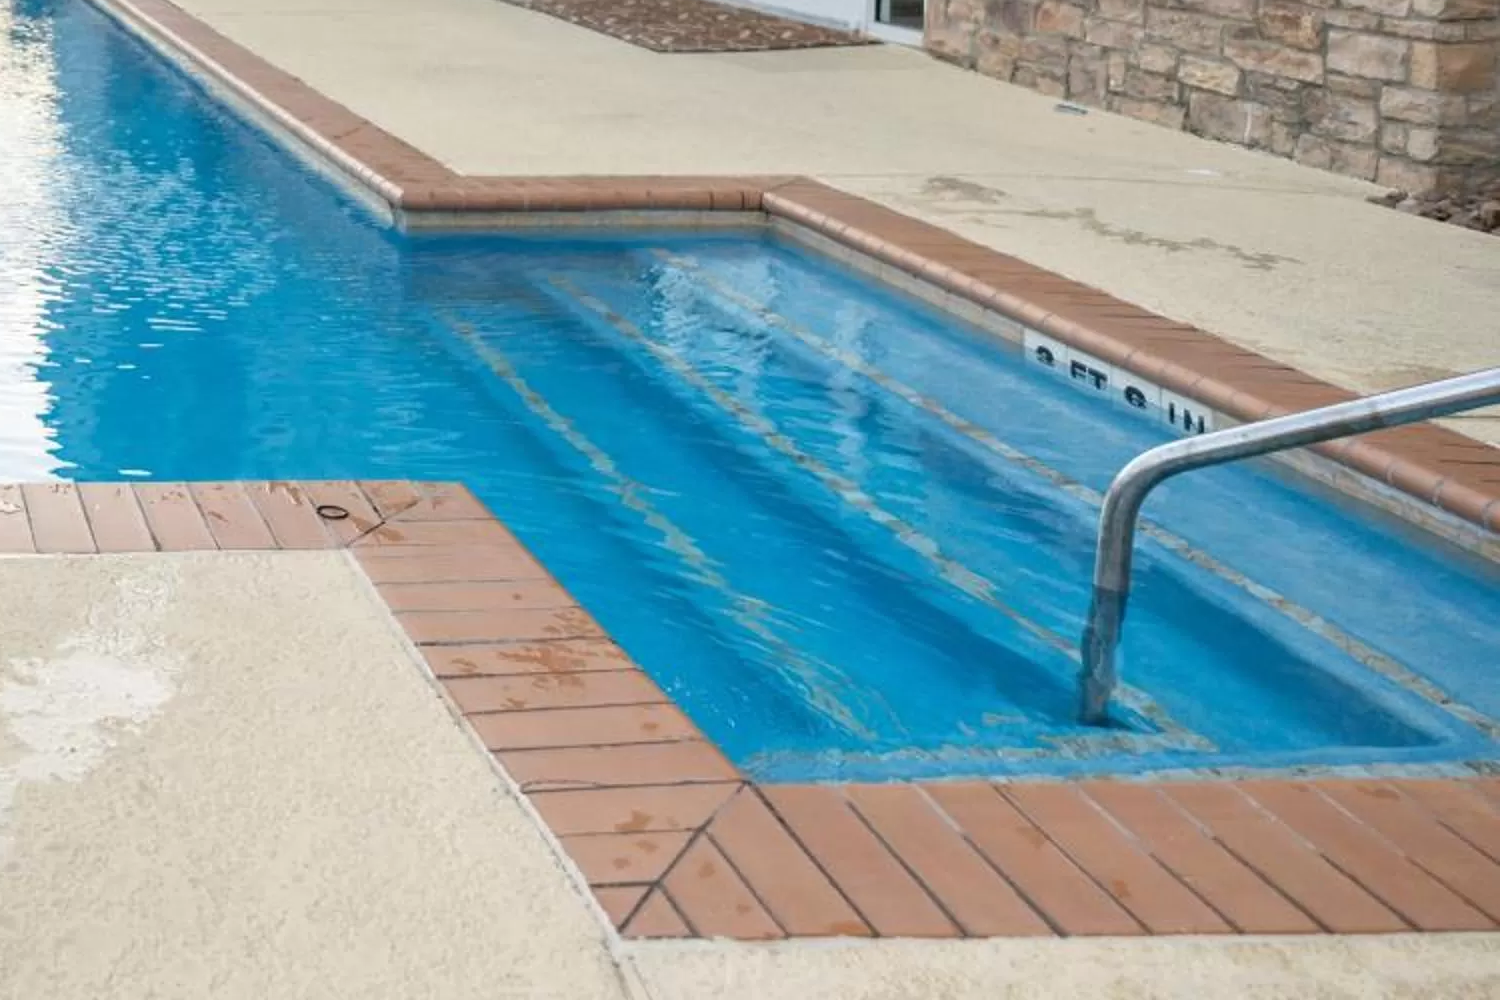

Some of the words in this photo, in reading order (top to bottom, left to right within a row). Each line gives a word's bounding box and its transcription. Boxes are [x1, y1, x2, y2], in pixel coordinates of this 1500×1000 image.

[1070, 359, 1108, 389] FT
[1124, 385, 1148, 409] 6
[1168, 402, 1205, 434] IN
